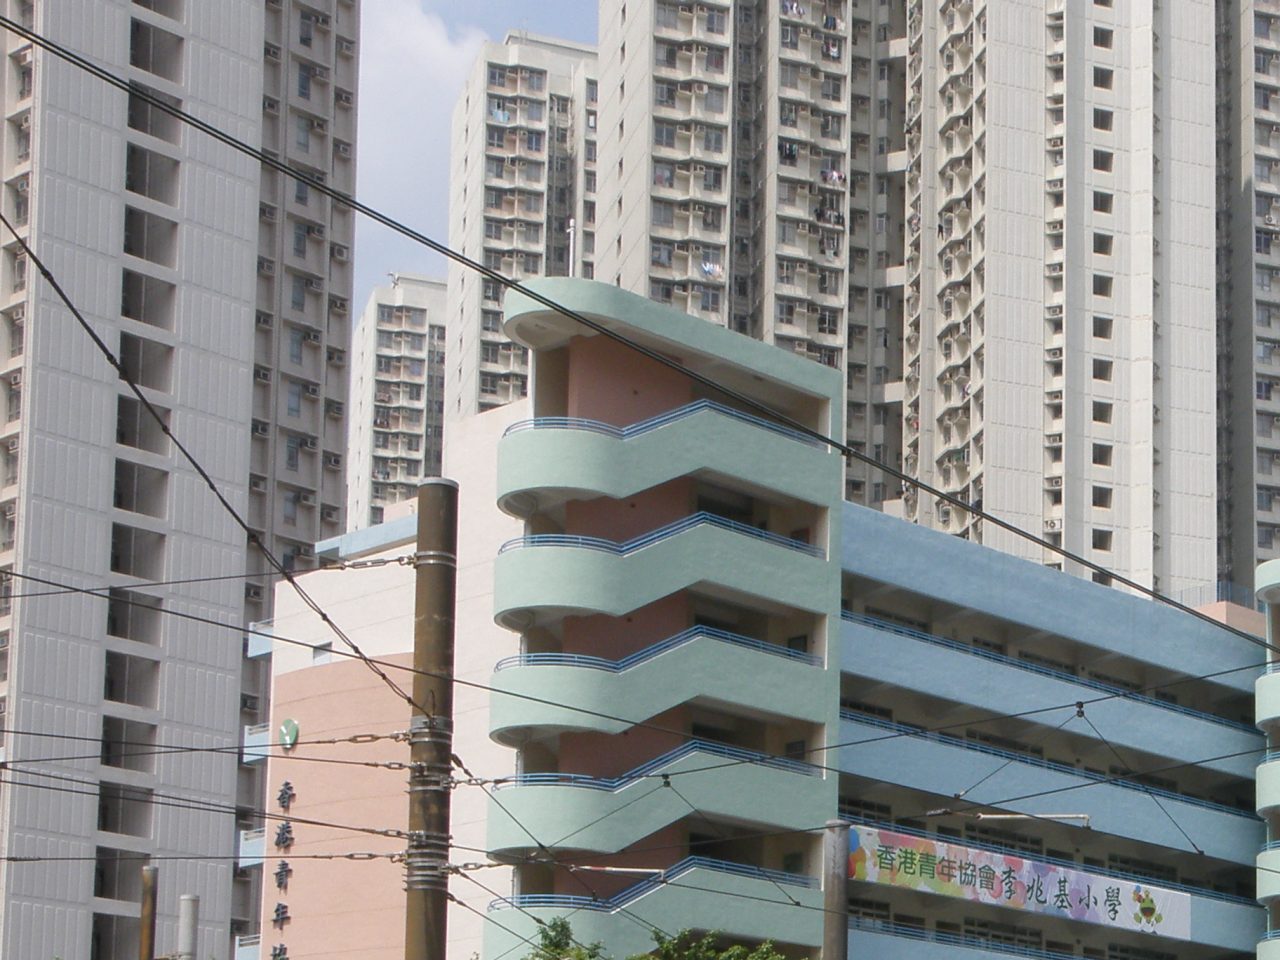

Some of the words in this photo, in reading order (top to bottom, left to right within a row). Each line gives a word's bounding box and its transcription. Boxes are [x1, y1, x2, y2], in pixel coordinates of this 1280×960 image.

[876, 844, 1123, 922] 香港青年協會李兆基小學
